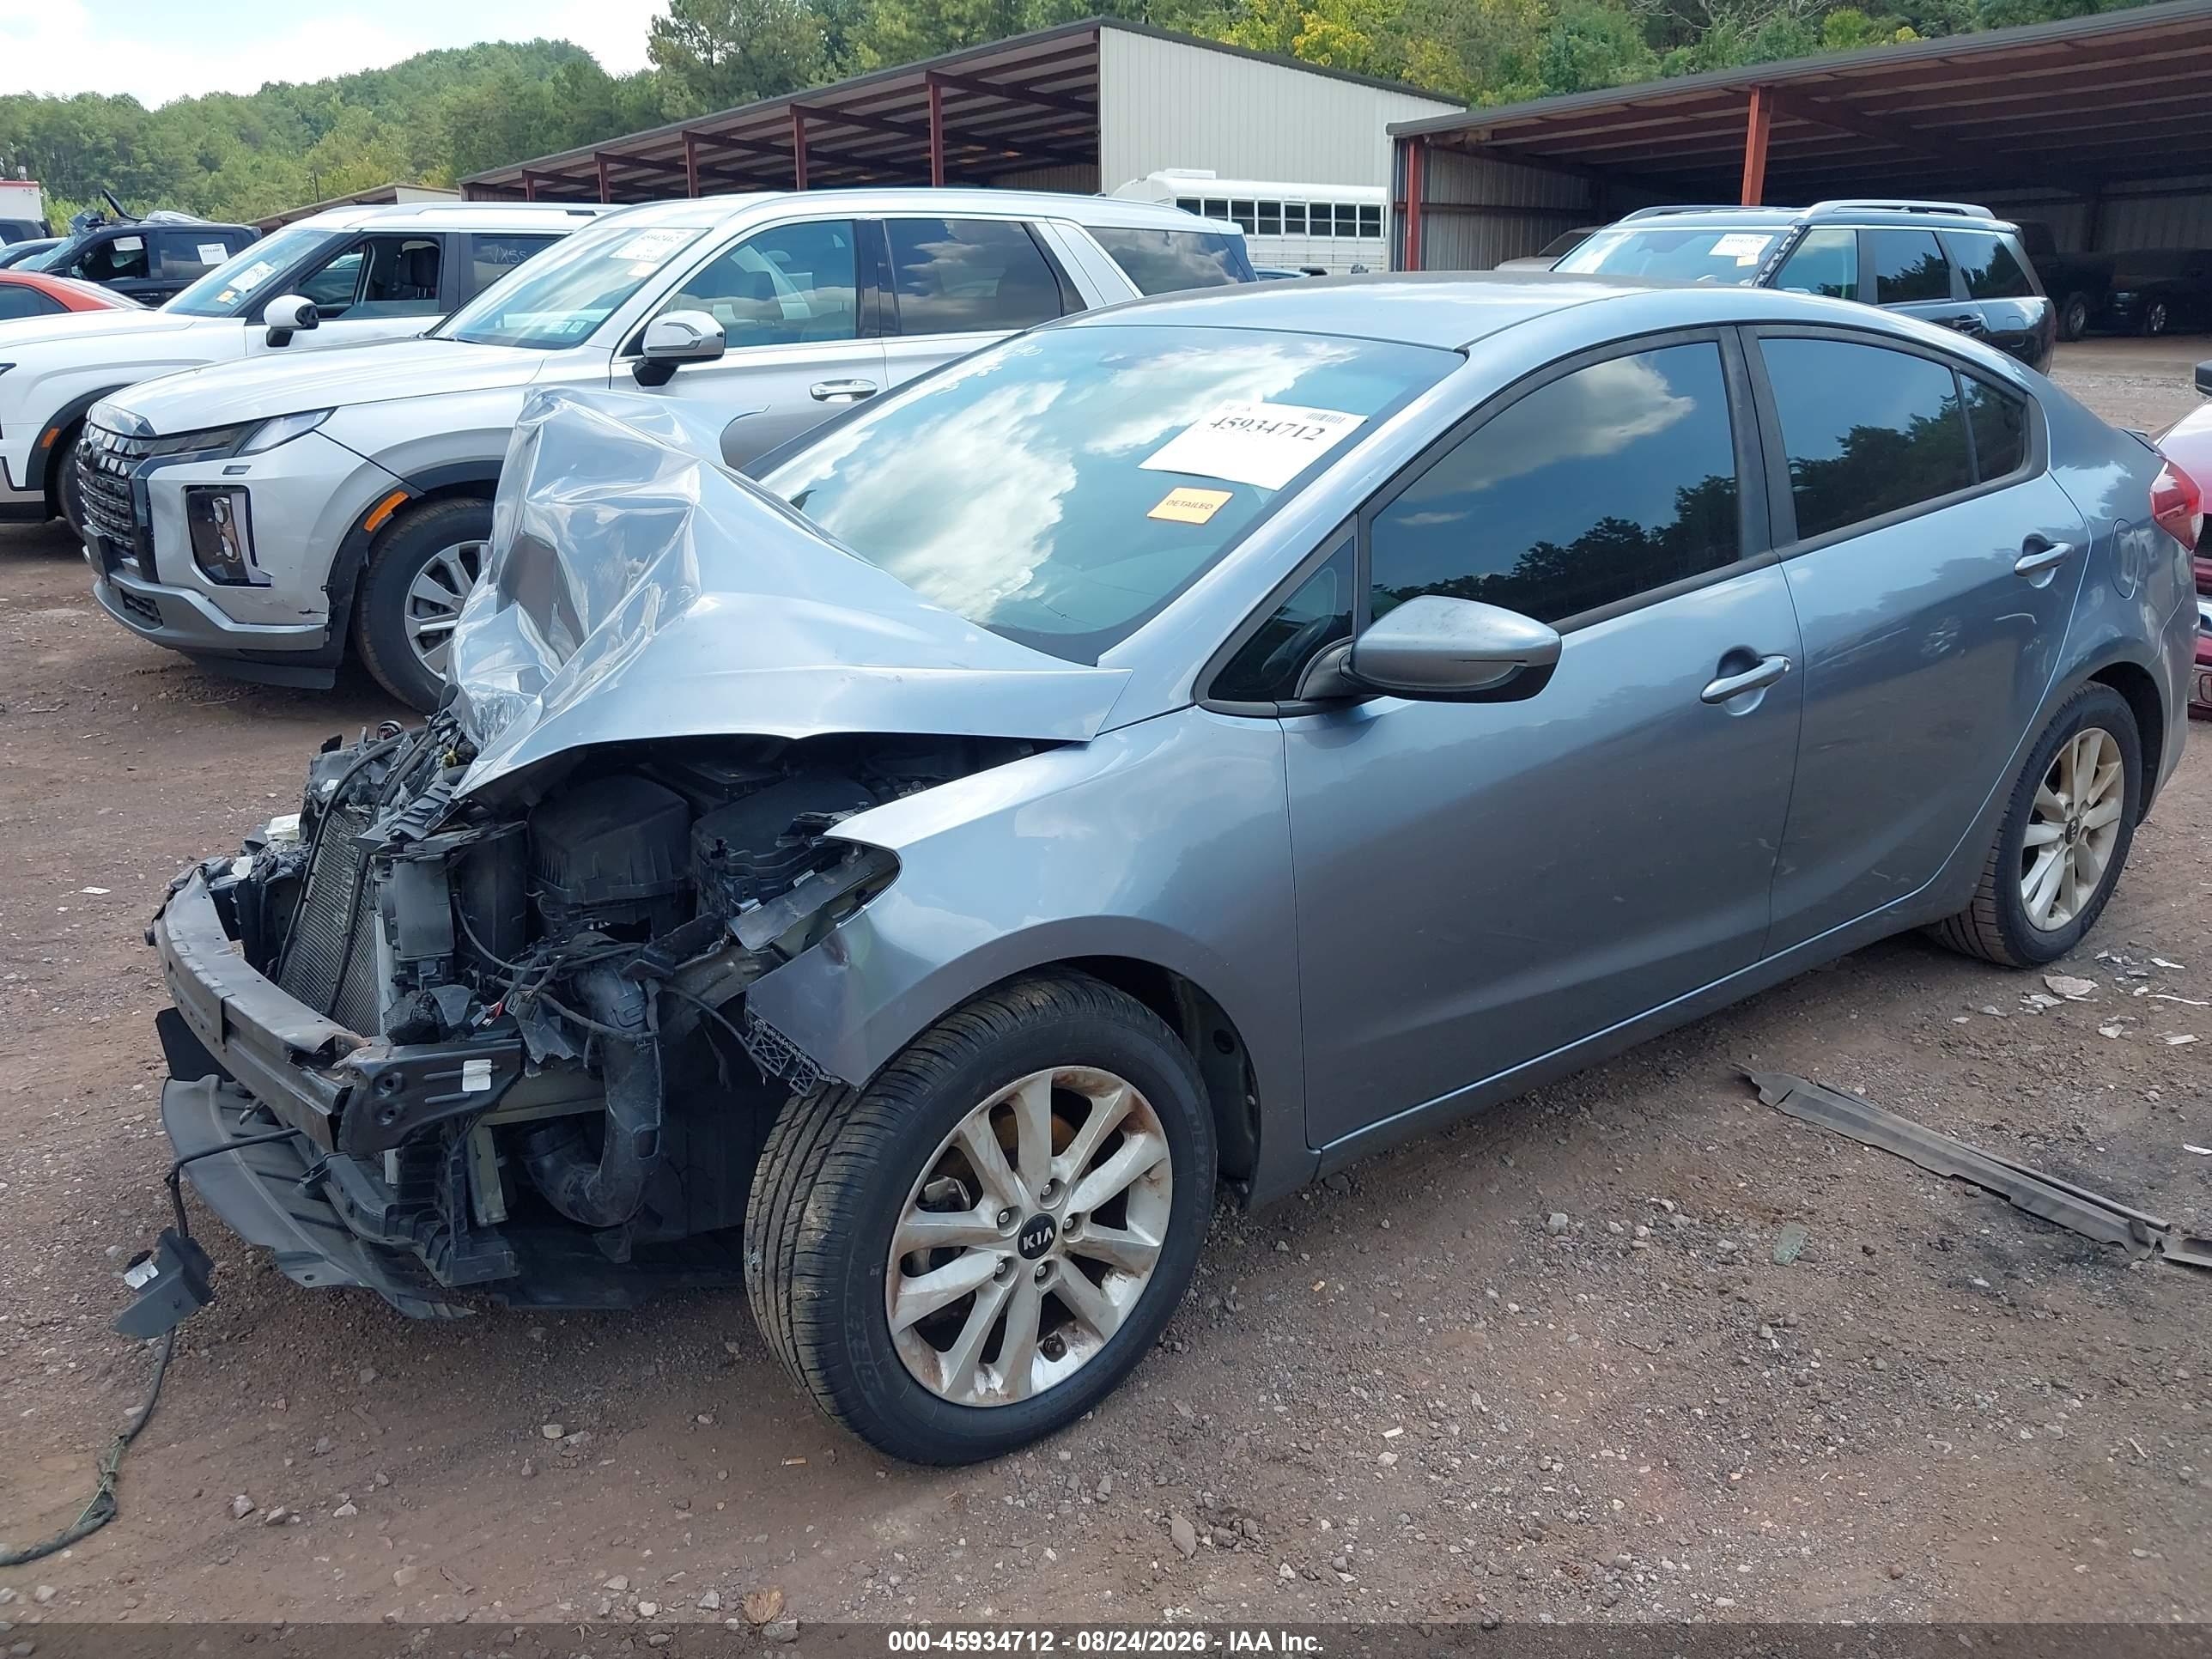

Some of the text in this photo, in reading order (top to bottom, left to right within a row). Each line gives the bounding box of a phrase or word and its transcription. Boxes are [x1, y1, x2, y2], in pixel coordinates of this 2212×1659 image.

[1209, 416, 1326, 441] 45934712
[1165, 499, 1215, 511] DETAILED
[1023, 1226, 1054, 1251] KIA
